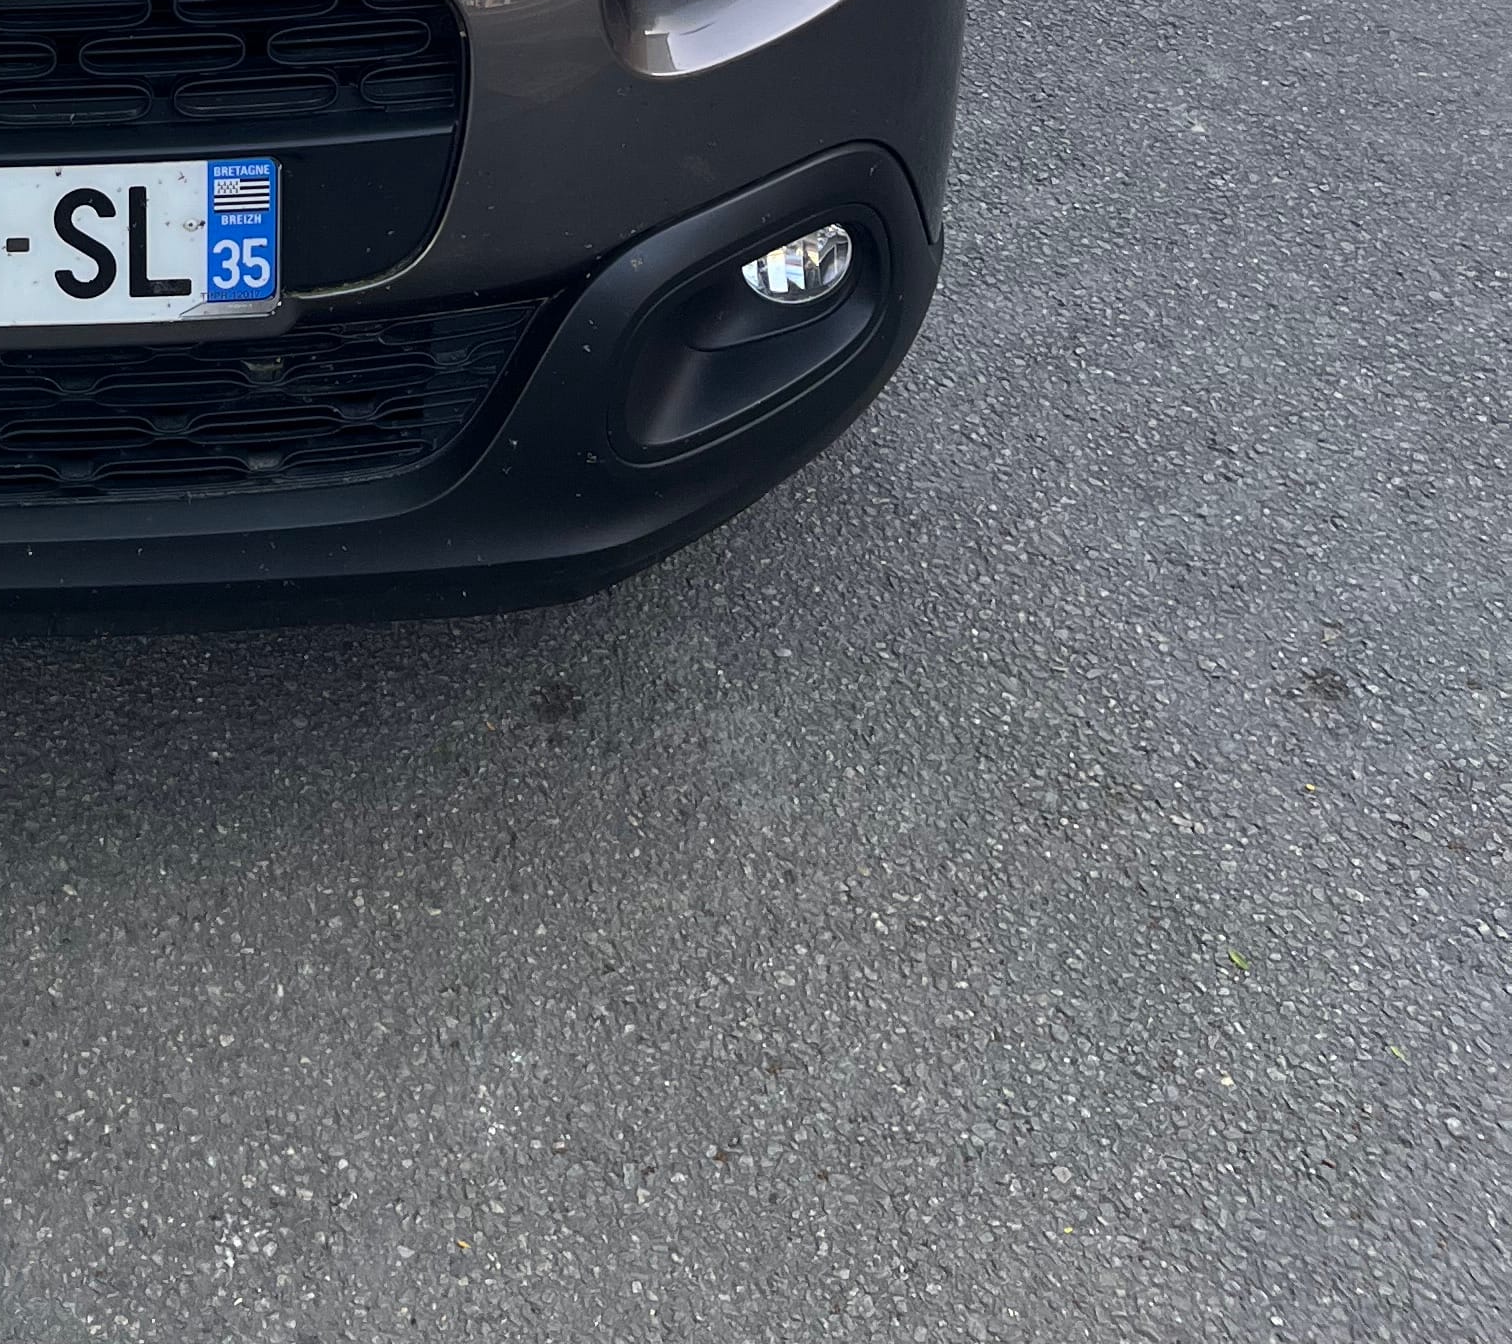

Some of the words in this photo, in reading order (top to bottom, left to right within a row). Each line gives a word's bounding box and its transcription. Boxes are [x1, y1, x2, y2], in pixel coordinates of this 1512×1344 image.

[213, 164, 270, 177] BRETAGNE
[220, 214, 262, 226] BREIZH
[212, 237, 271, 290] 35
